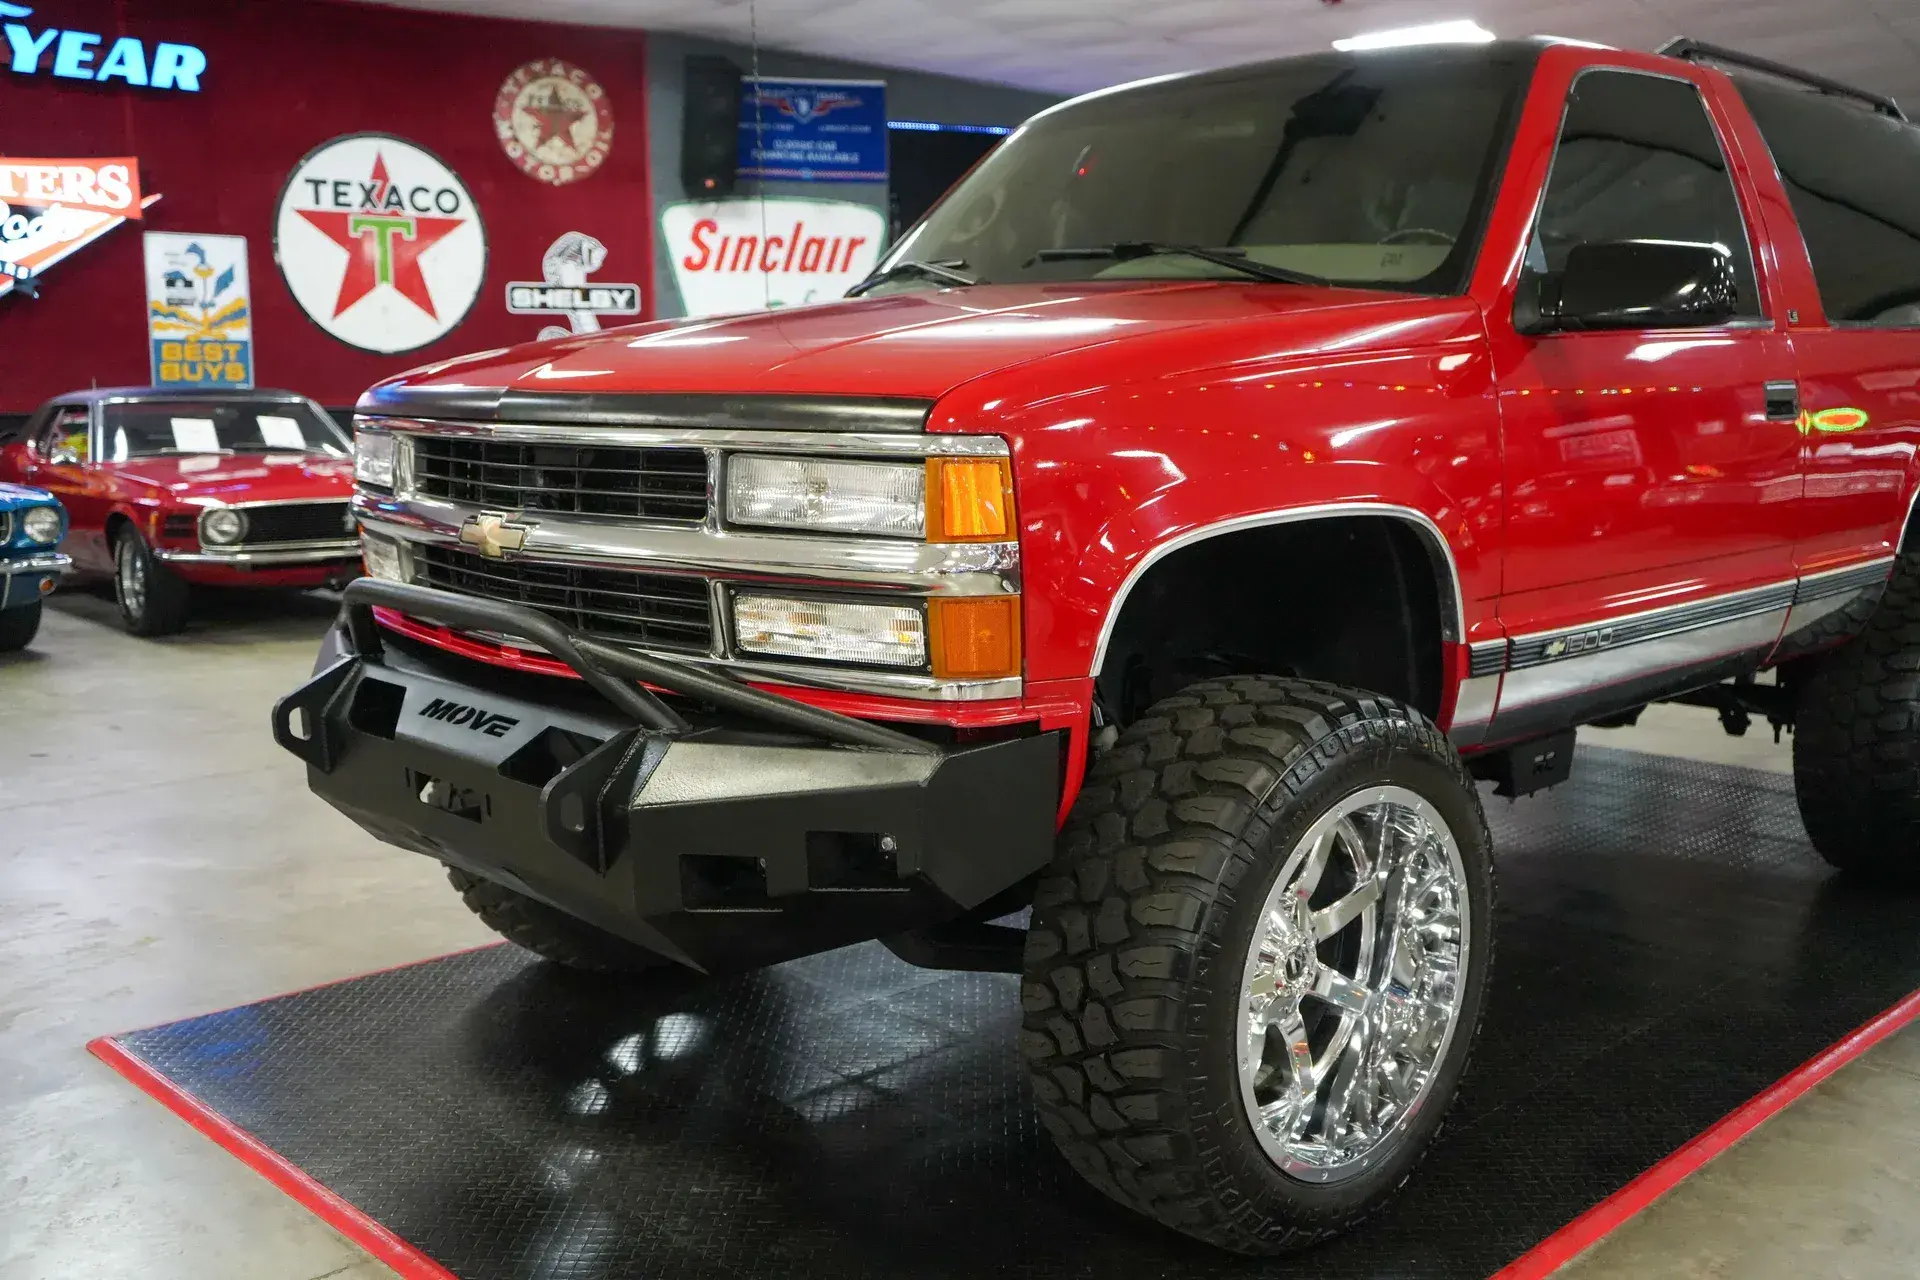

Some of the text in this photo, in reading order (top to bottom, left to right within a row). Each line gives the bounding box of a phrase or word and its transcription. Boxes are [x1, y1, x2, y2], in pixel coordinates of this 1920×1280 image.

[4, 23, 207, 92] YEAR
[305, 177, 460, 214] TEXACO
[683, 218, 866, 273] Sinclair
[511, 287, 634, 310] SHELBY
[161, 341, 244, 362] BEST
[159, 362, 247, 382] BUYS
[418, 698, 520, 737] MOVE
